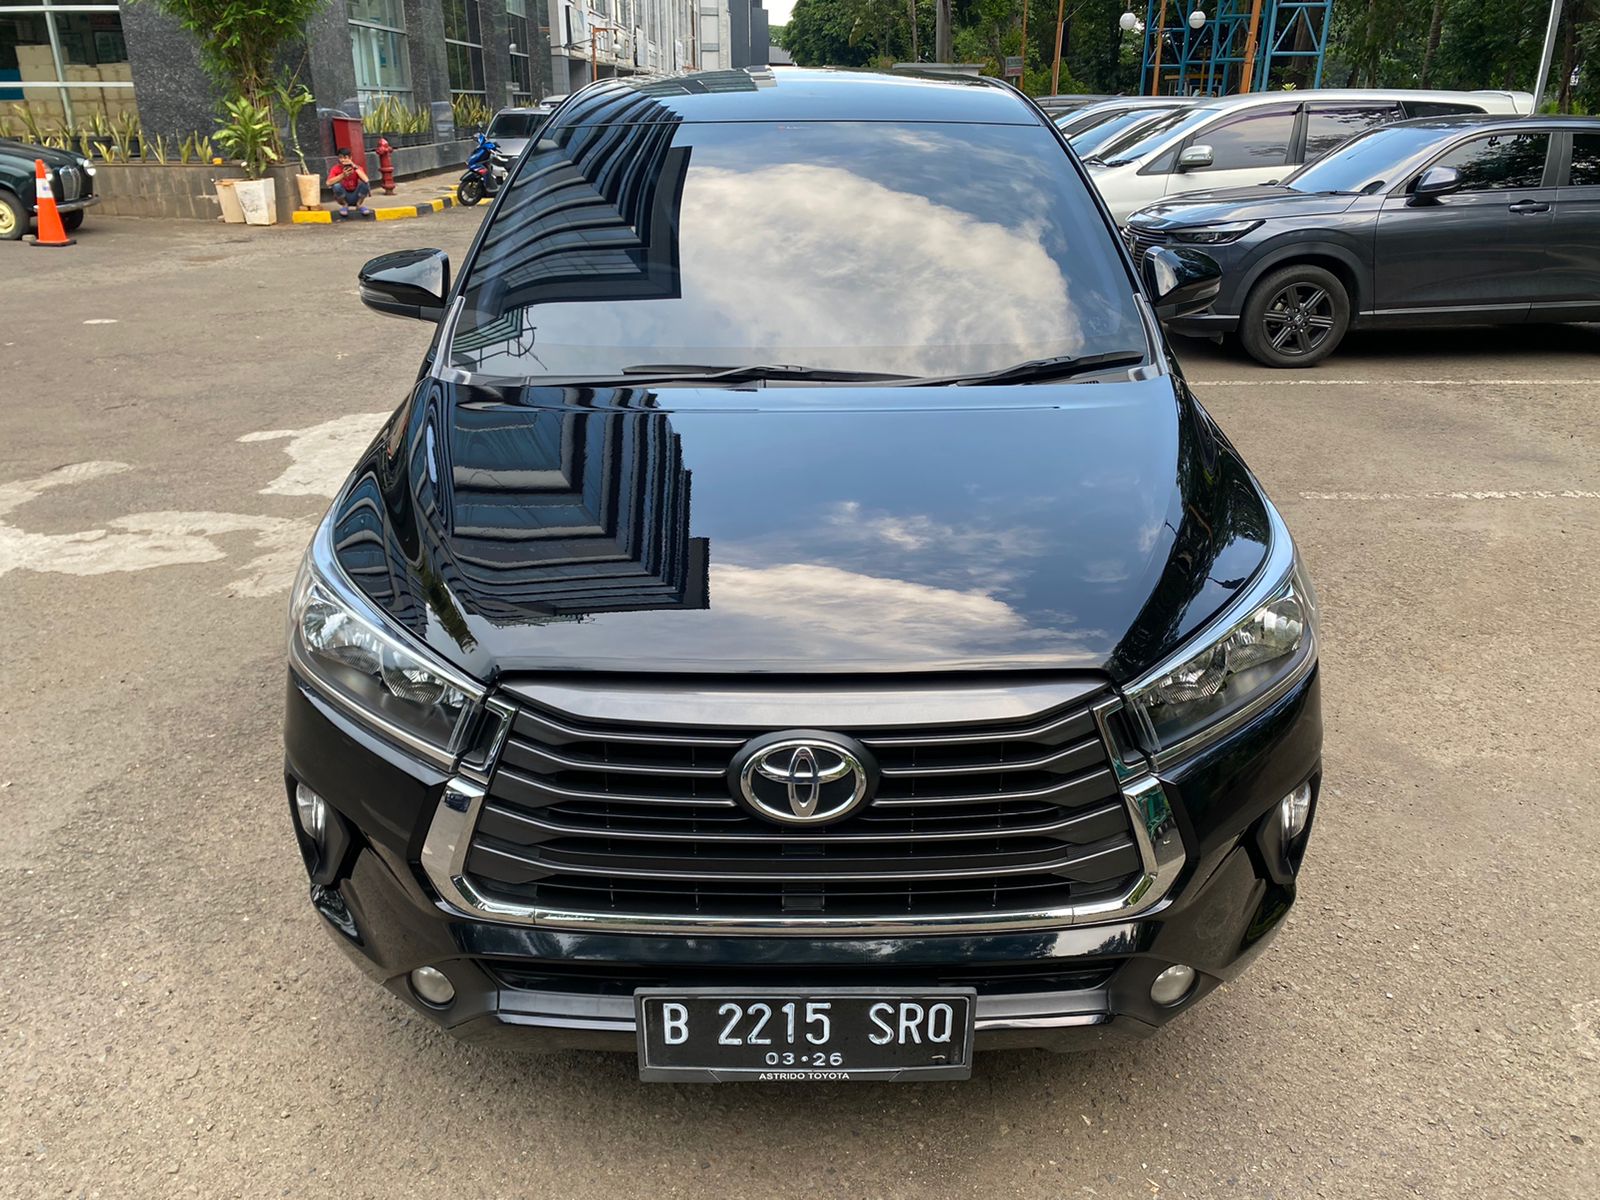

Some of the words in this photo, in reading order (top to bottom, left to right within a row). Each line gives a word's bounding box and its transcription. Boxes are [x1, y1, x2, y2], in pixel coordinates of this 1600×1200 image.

[663, 1002, 689, 1045] B
[718, 1002, 832, 1045] 2215
[868, 1002, 953, 1045] SRQ
[758, 1072, 805, 1081] ASTRIDO
[807, 1072, 850, 1081] TOYOTA
